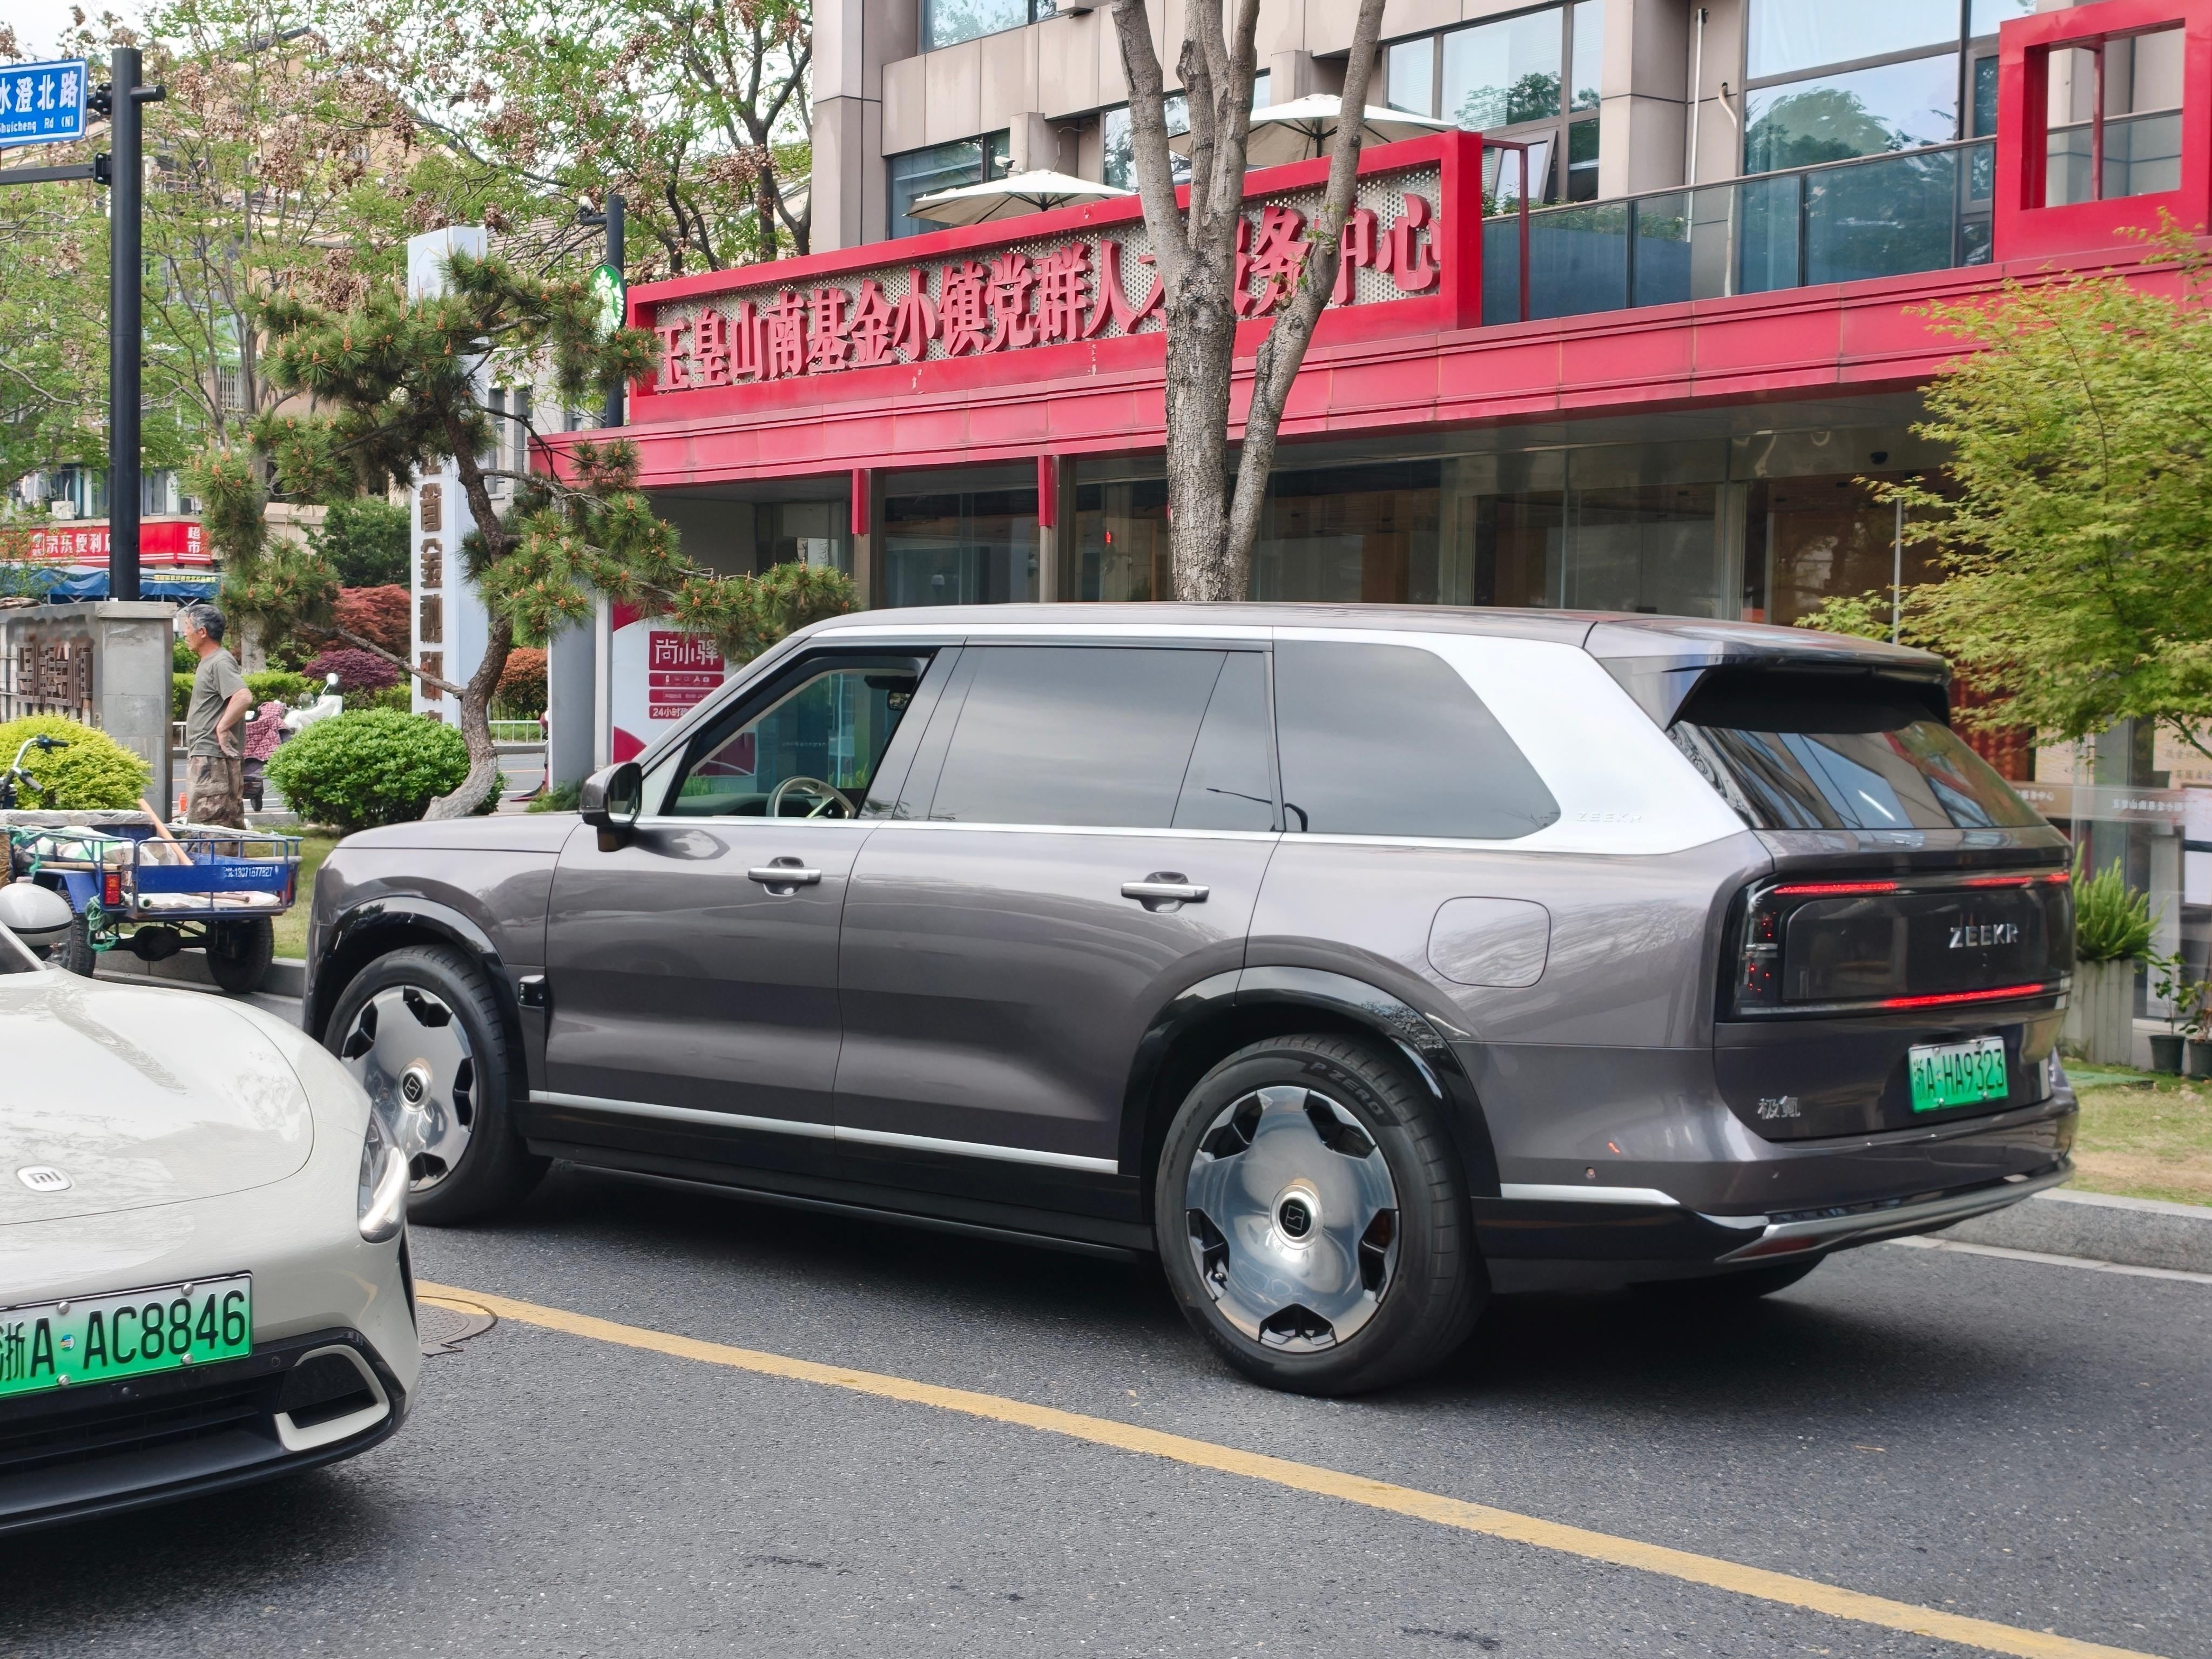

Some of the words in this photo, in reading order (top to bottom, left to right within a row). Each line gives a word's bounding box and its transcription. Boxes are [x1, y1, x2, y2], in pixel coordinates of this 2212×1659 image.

[0, 70, 79, 115] 水澄北路
[44, 117, 54, 129] Rd
[188, 527, 200, 554] 超市
[1949, 923, 2018, 949] ZEEKR
[1942, 1048, 2005, 1097] HA9323
[83, 1290, 245, 1370] AC8846
